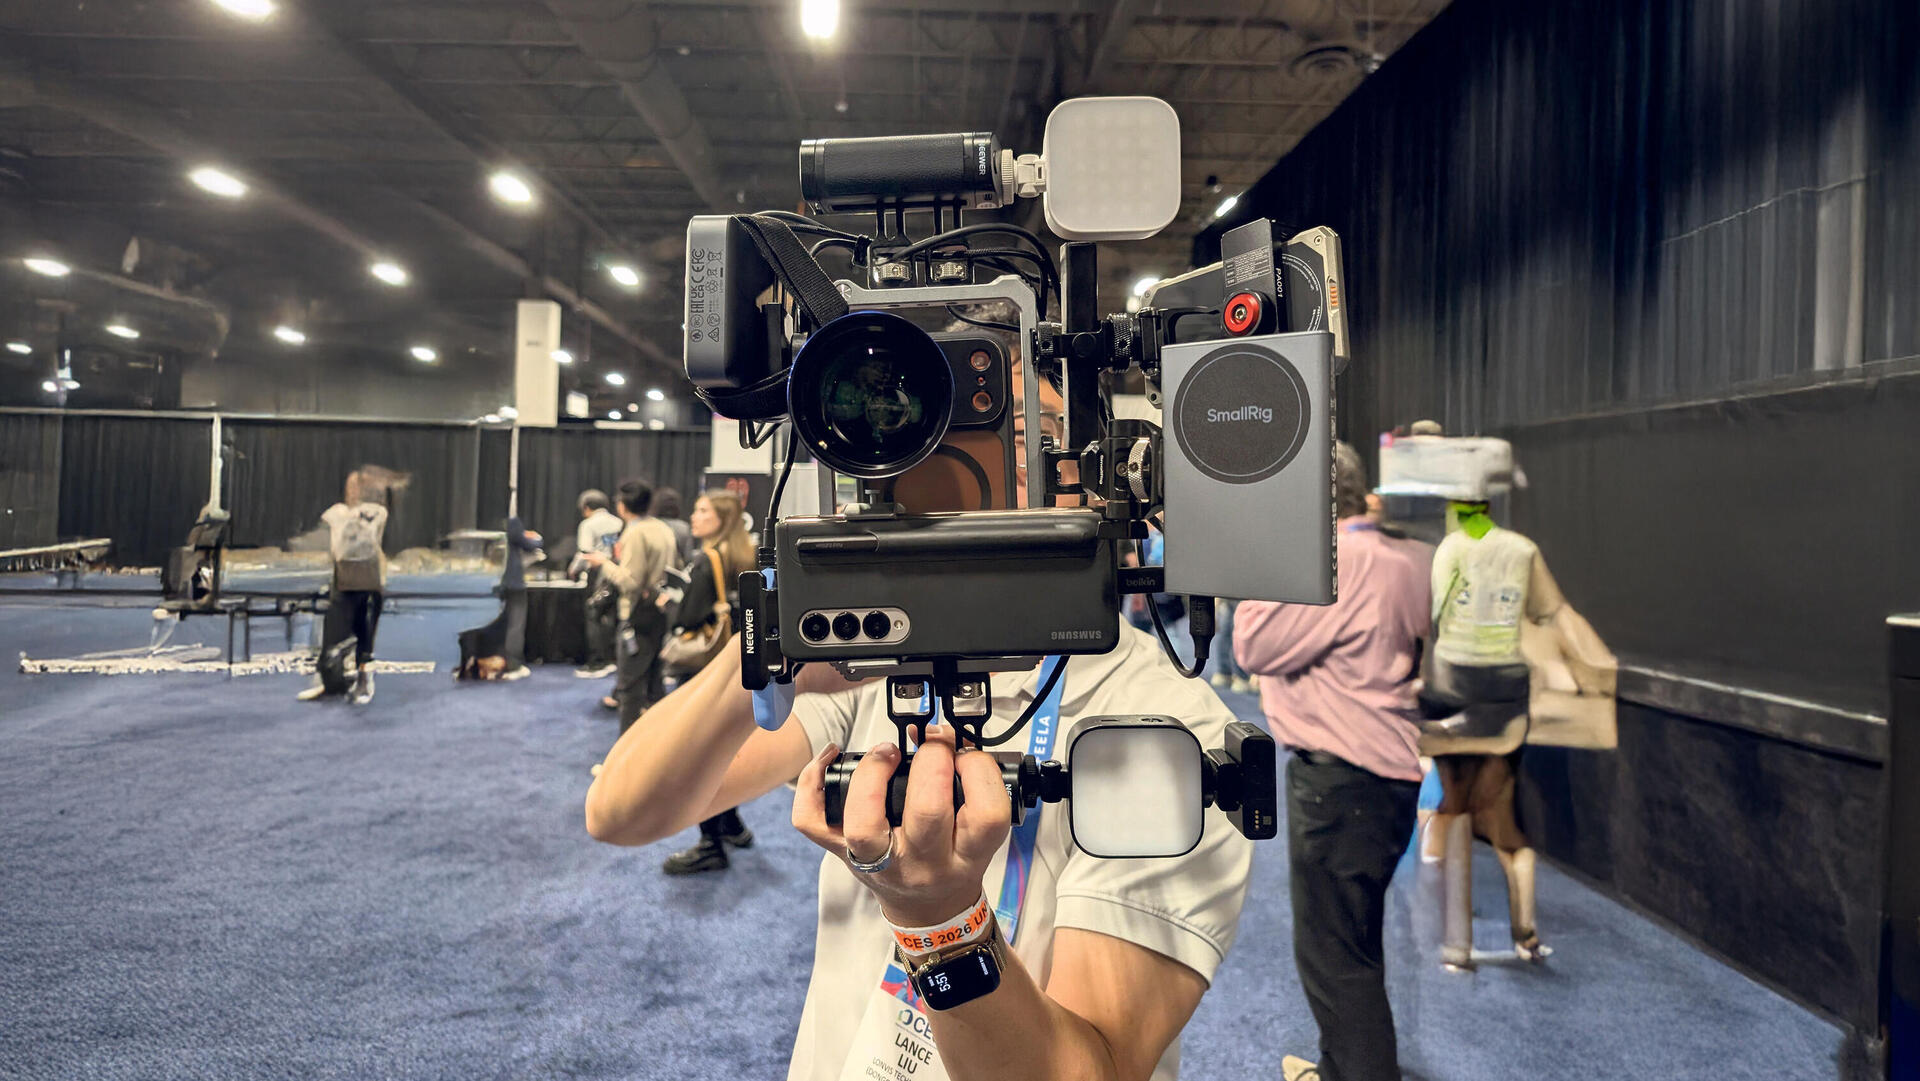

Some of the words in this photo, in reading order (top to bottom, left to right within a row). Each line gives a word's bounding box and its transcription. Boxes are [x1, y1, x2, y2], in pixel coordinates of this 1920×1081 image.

[1207, 405, 1273, 424] SmallRig
[745, 608, 754, 654] NEEWER
[1051, 630, 1102, 640] SAMSUNG
[903, 937, 934, 949] CES
[937, 923, 972, 945] 2026
[895, 1032, 933, 1065] LANCE
[872, 1056, 894, 1075] LONVIS
[897, 1053, 918, 1074] LIU
